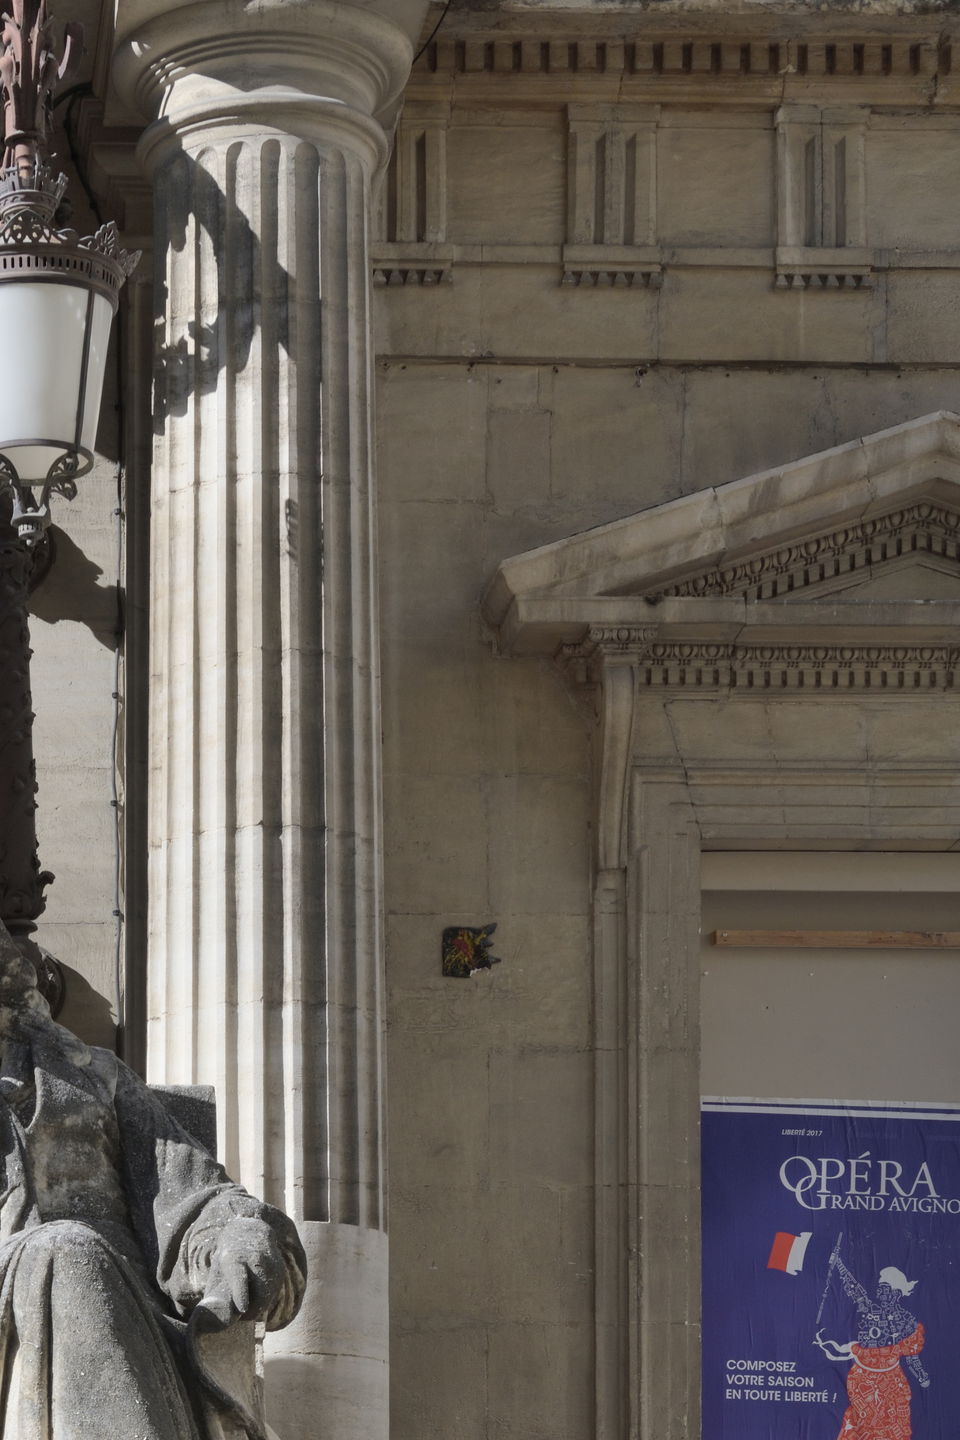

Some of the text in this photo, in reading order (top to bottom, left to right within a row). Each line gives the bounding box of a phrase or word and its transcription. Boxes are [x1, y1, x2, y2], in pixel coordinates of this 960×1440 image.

[781, 1128, 823, 1137] LIBERTÉ 2017
[779, 1151, 940, 1198] OPÉRA
[795, 1175, 886, 1211] GRAND
[726, 1360, 796, 1372] COMPOSEZ
[726, 1374, 814, 1387] VOTRE SAISON
[725, 1389, 741, 1400] EN
[744, 1389, 781, 1401] TOUTE
[785, 1390, 829, 1403] LIBERTÉ
